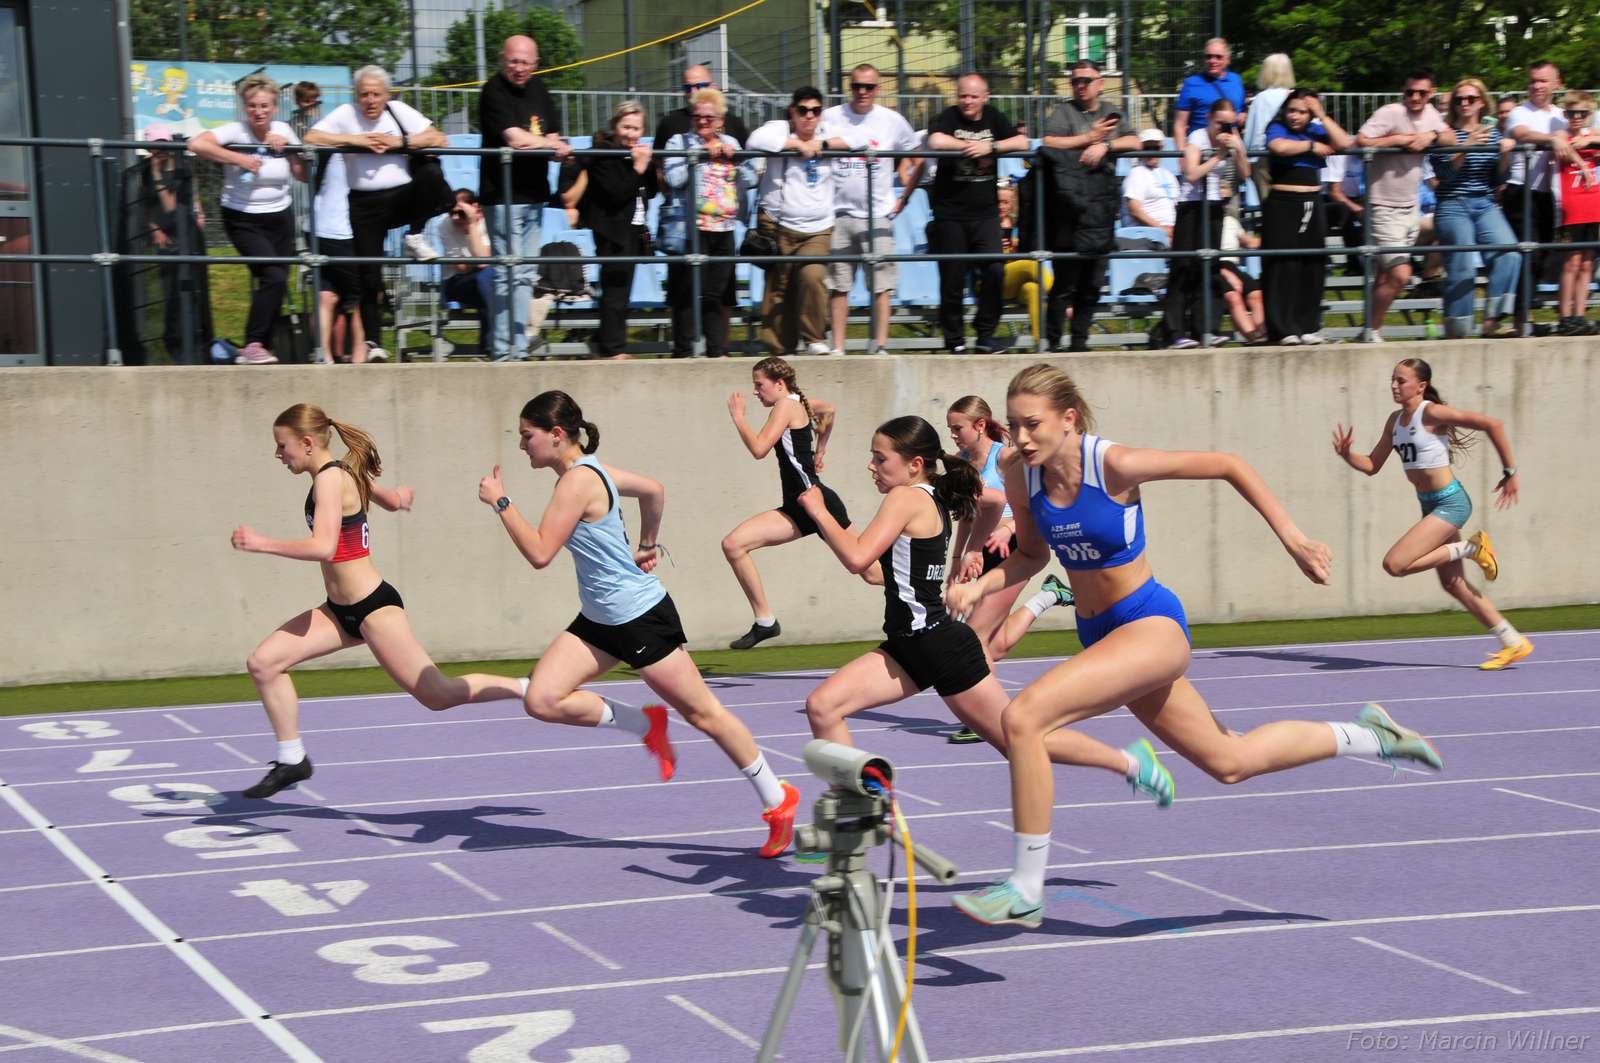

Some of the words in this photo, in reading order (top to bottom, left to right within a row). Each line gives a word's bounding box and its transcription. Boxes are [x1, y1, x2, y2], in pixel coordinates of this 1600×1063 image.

[18, 720, 122, 740] 8
[75, 749, 179, 773] 7
[108, 782, 229, 811] 6
[163, 825, 302, 859] 5
[231, 878, 370, 917] 4
[317, 935, 490, 985] 3
[419, 1009, 632, 1063] 2
